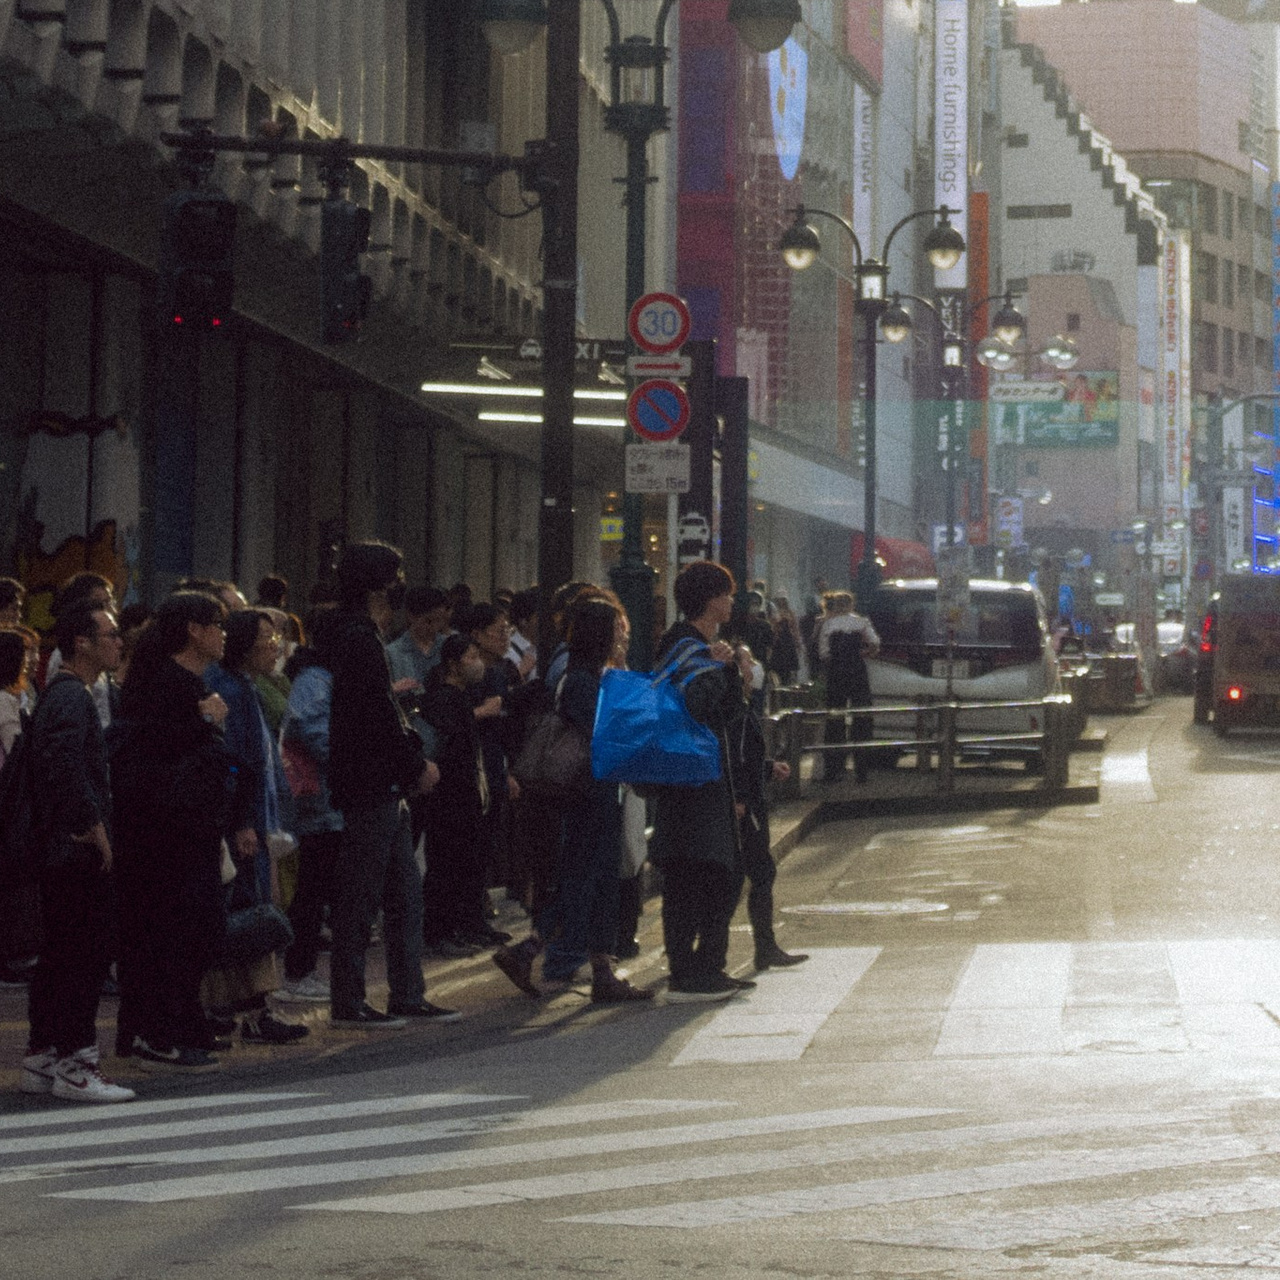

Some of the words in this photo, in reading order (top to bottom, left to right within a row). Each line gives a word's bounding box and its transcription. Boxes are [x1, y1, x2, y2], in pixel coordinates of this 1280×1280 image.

[942, 18, 962, 77] Home
[937, 83, 963, 193] furnishings
[642, 309, 678, 337] 30
